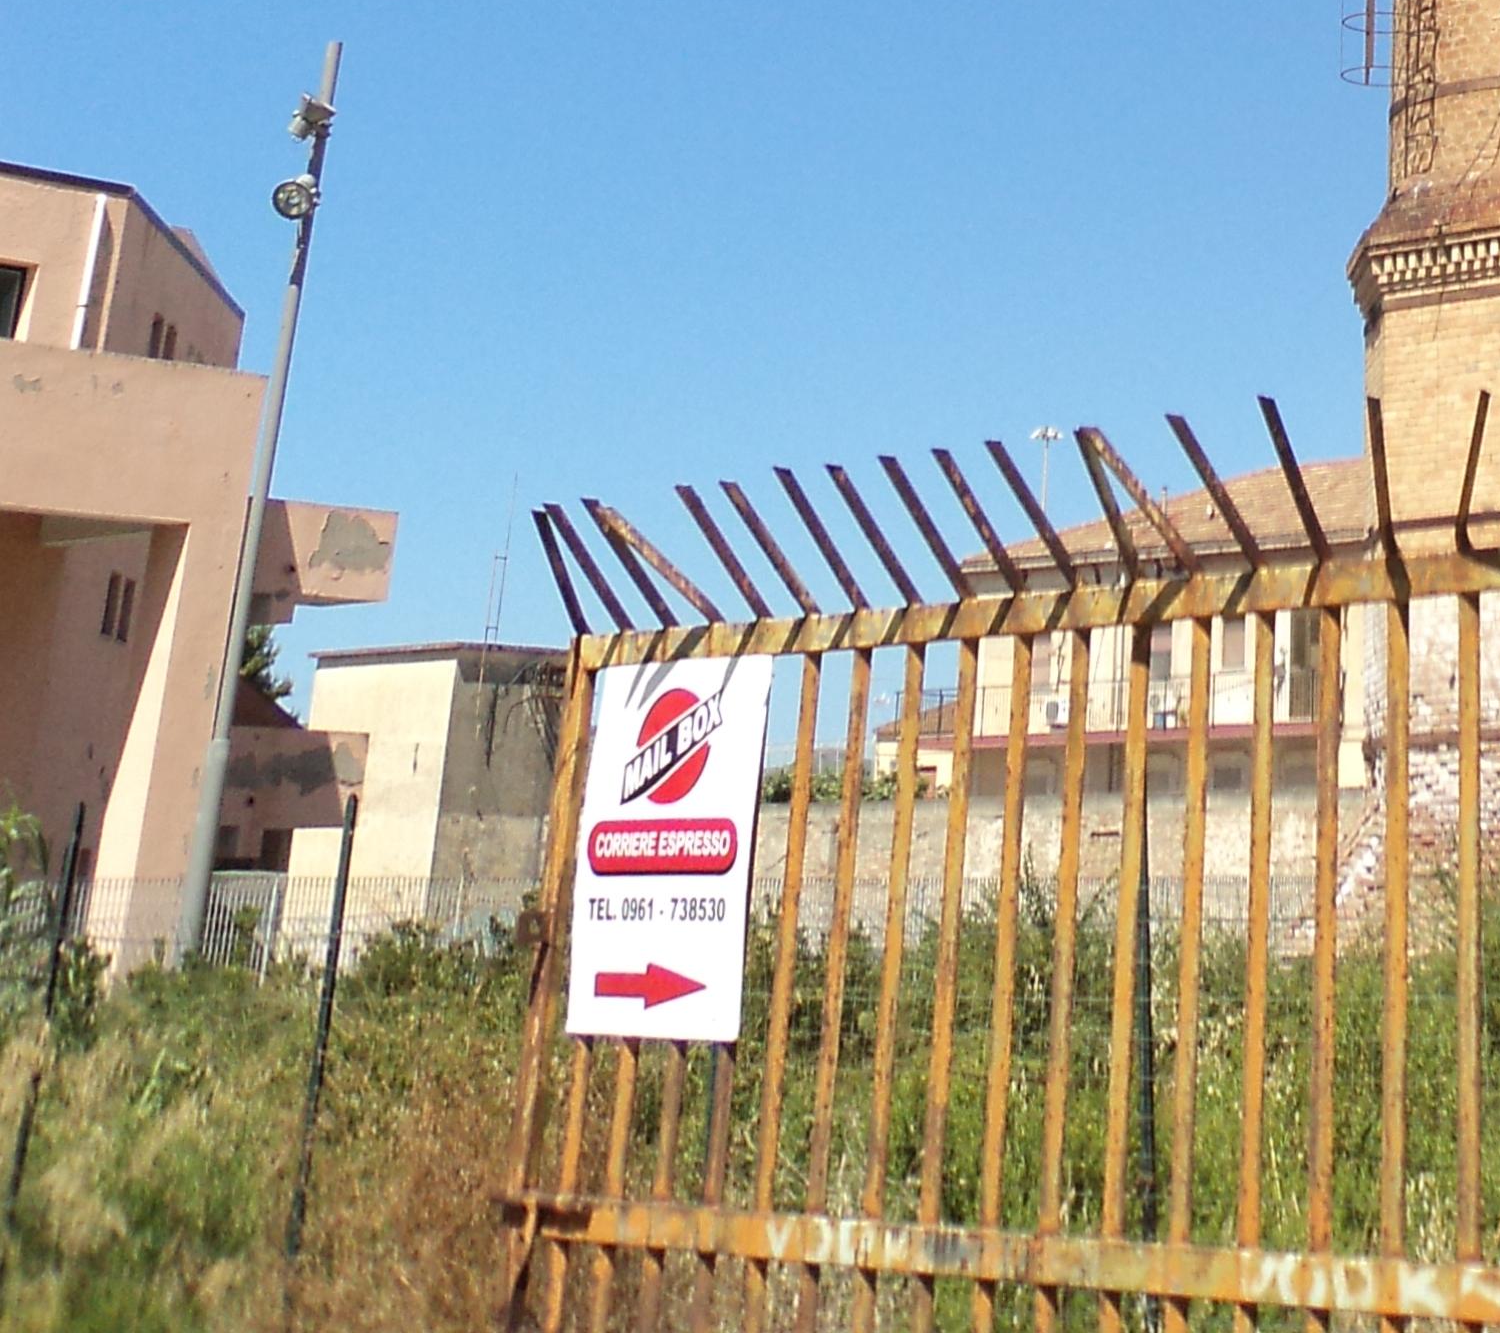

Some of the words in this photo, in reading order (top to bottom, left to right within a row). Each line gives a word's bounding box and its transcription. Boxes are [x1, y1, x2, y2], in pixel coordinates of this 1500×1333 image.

[623, 733, 674, 801] MAIL
[676, 690, 723, 756] BOX
[595, 832, 657, 858] CORRIERE
[657, 830, 731, 857] ESPRESSO
[589, 898, 617, 921] TEL.
[622, 898, 654, 921] 0961
[670, 898, 726, 922] 738530
